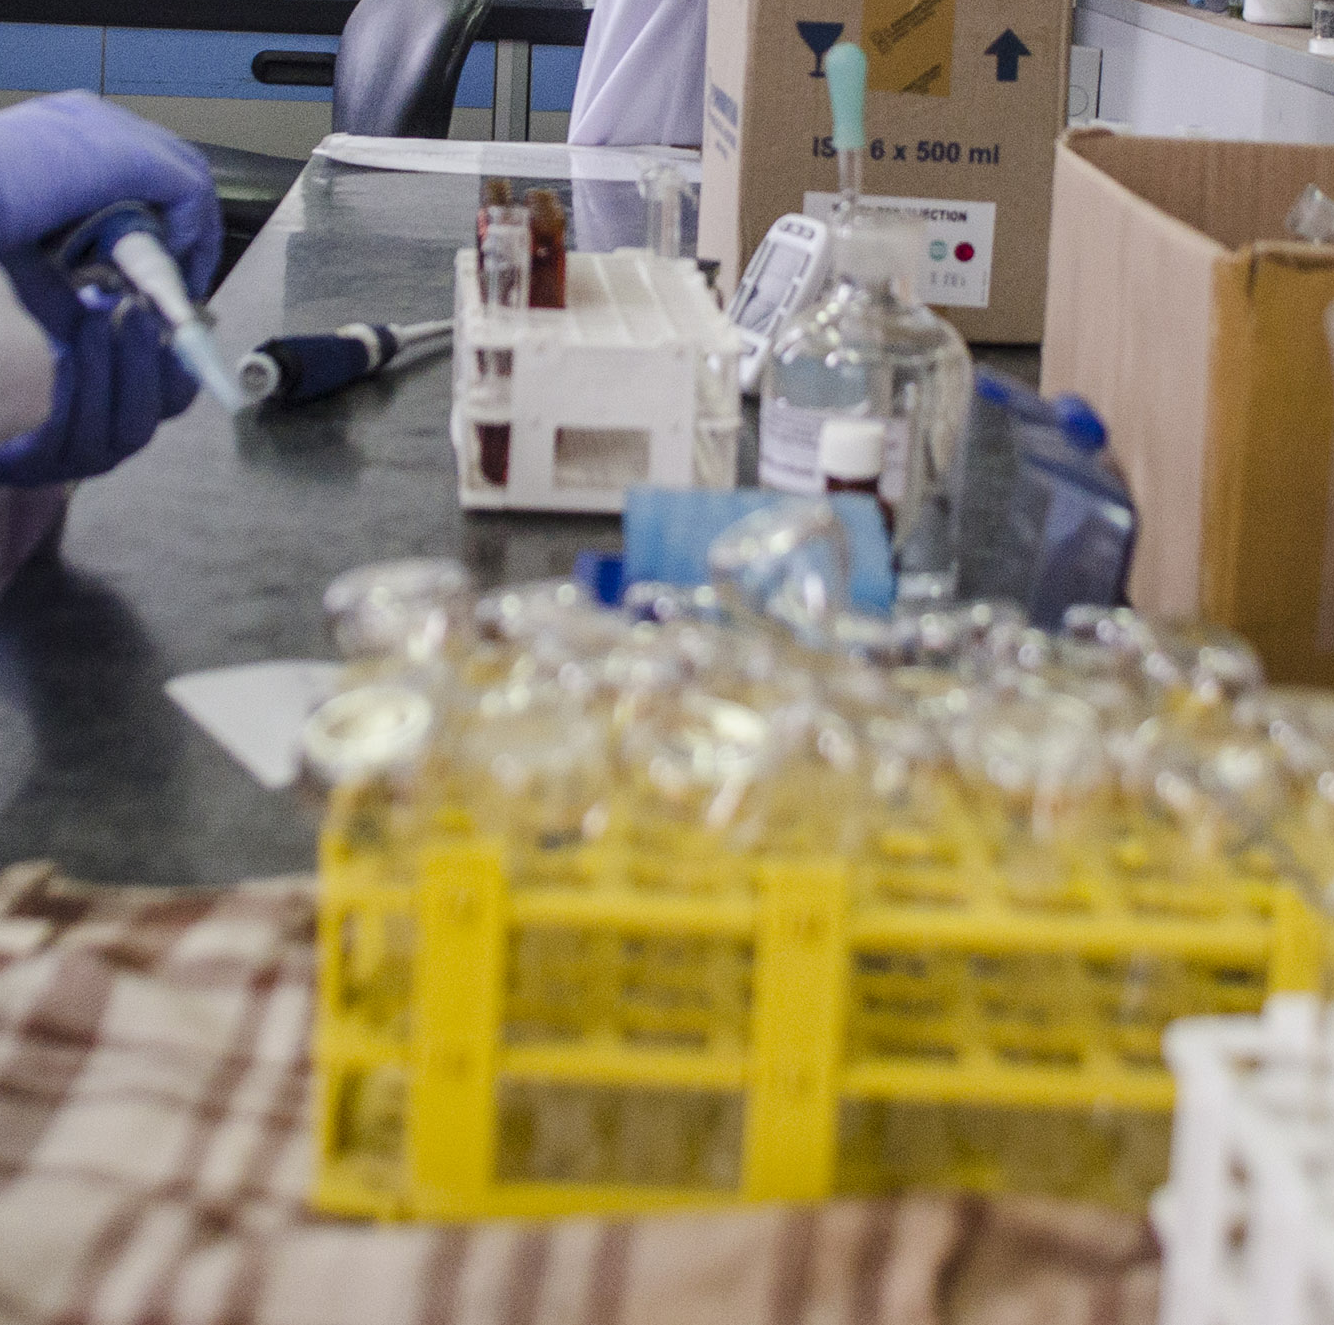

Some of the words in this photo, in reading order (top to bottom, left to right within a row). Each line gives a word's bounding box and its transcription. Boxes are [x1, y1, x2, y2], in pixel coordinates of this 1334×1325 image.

[870, 138, 885, 160] 6
[893, 144, 907, 161] x
[916, 140, 961, 163] 500
[969, 143, 999, 164] ml
